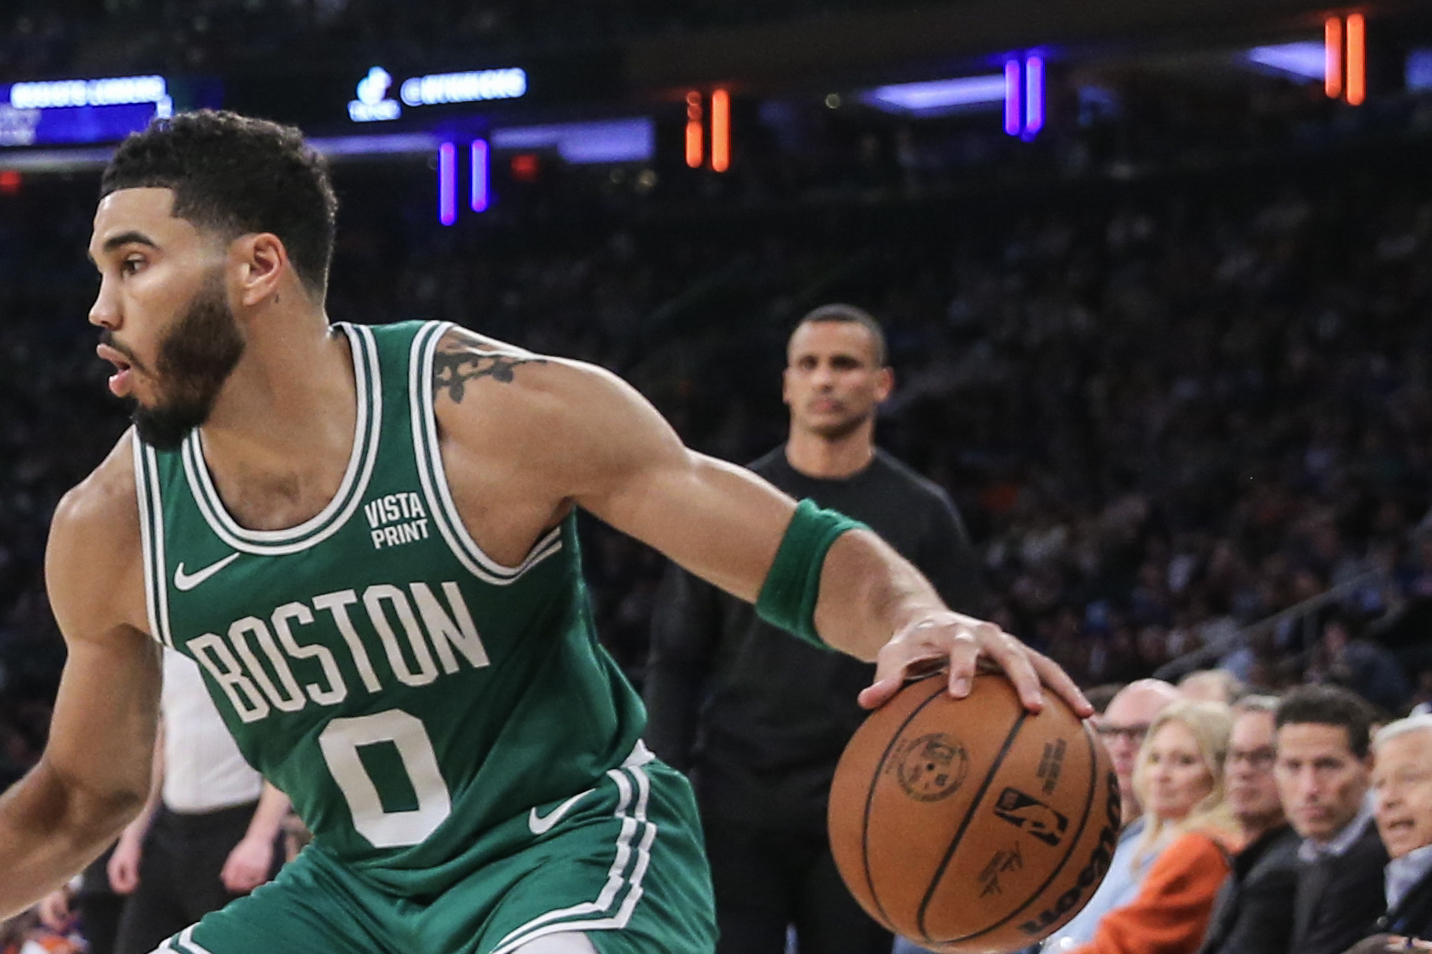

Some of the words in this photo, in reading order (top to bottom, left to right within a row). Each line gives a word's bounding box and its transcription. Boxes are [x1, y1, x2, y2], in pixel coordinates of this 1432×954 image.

[364, 492, 426, 529] VISTA
[371, 518, 429, 550] PRINT
[187, 581, 491, 724] BOSTON
[318, 707, 452, 848] 0
